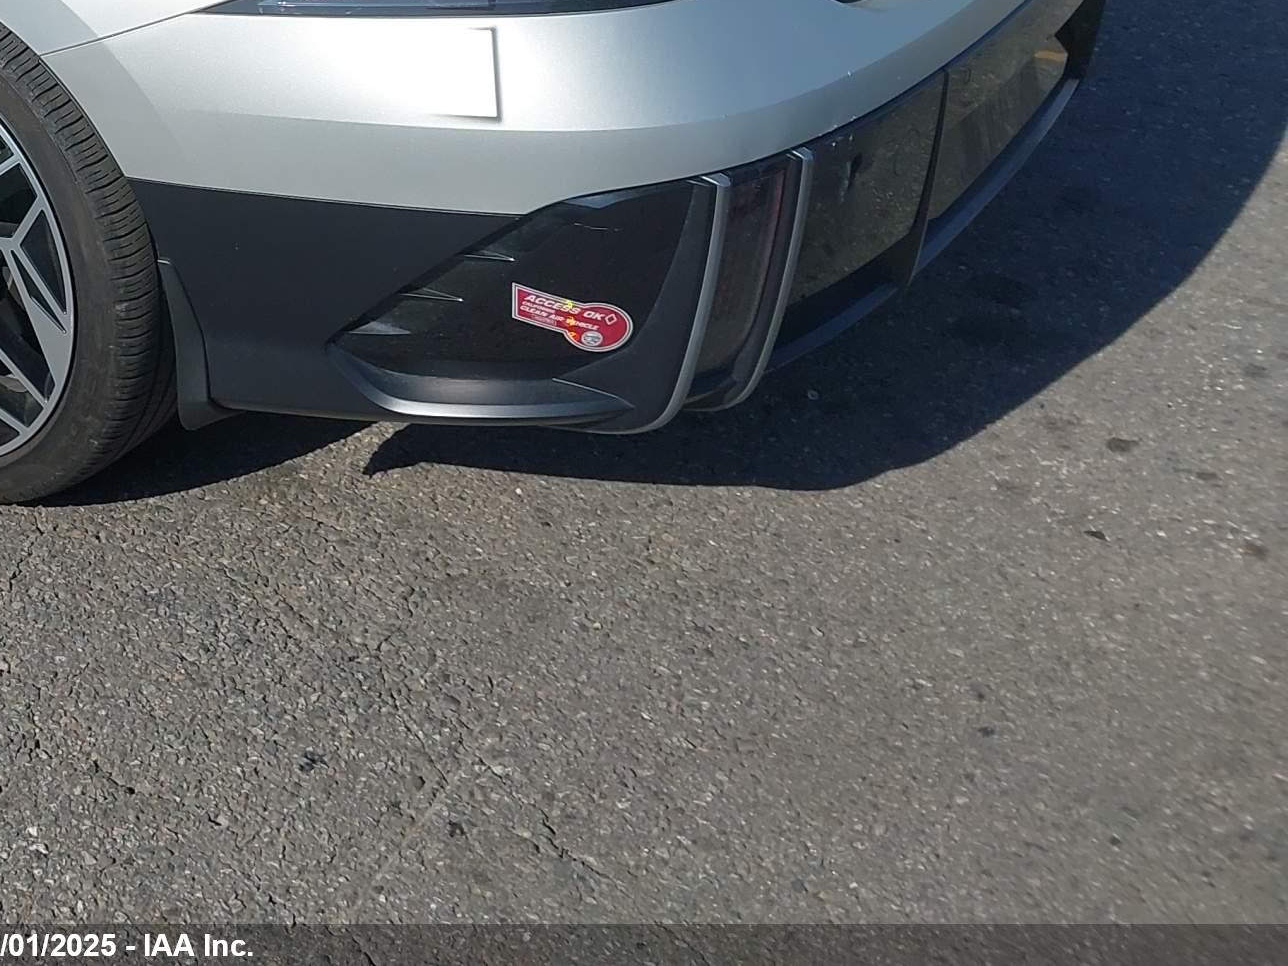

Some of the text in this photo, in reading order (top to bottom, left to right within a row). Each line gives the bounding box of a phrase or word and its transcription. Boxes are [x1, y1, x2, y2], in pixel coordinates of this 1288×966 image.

[519, 305, 549, 317] CLEAN
[548, 314, 565, 322] AIR
[524, 294, 606, 321] ACCESS OK
